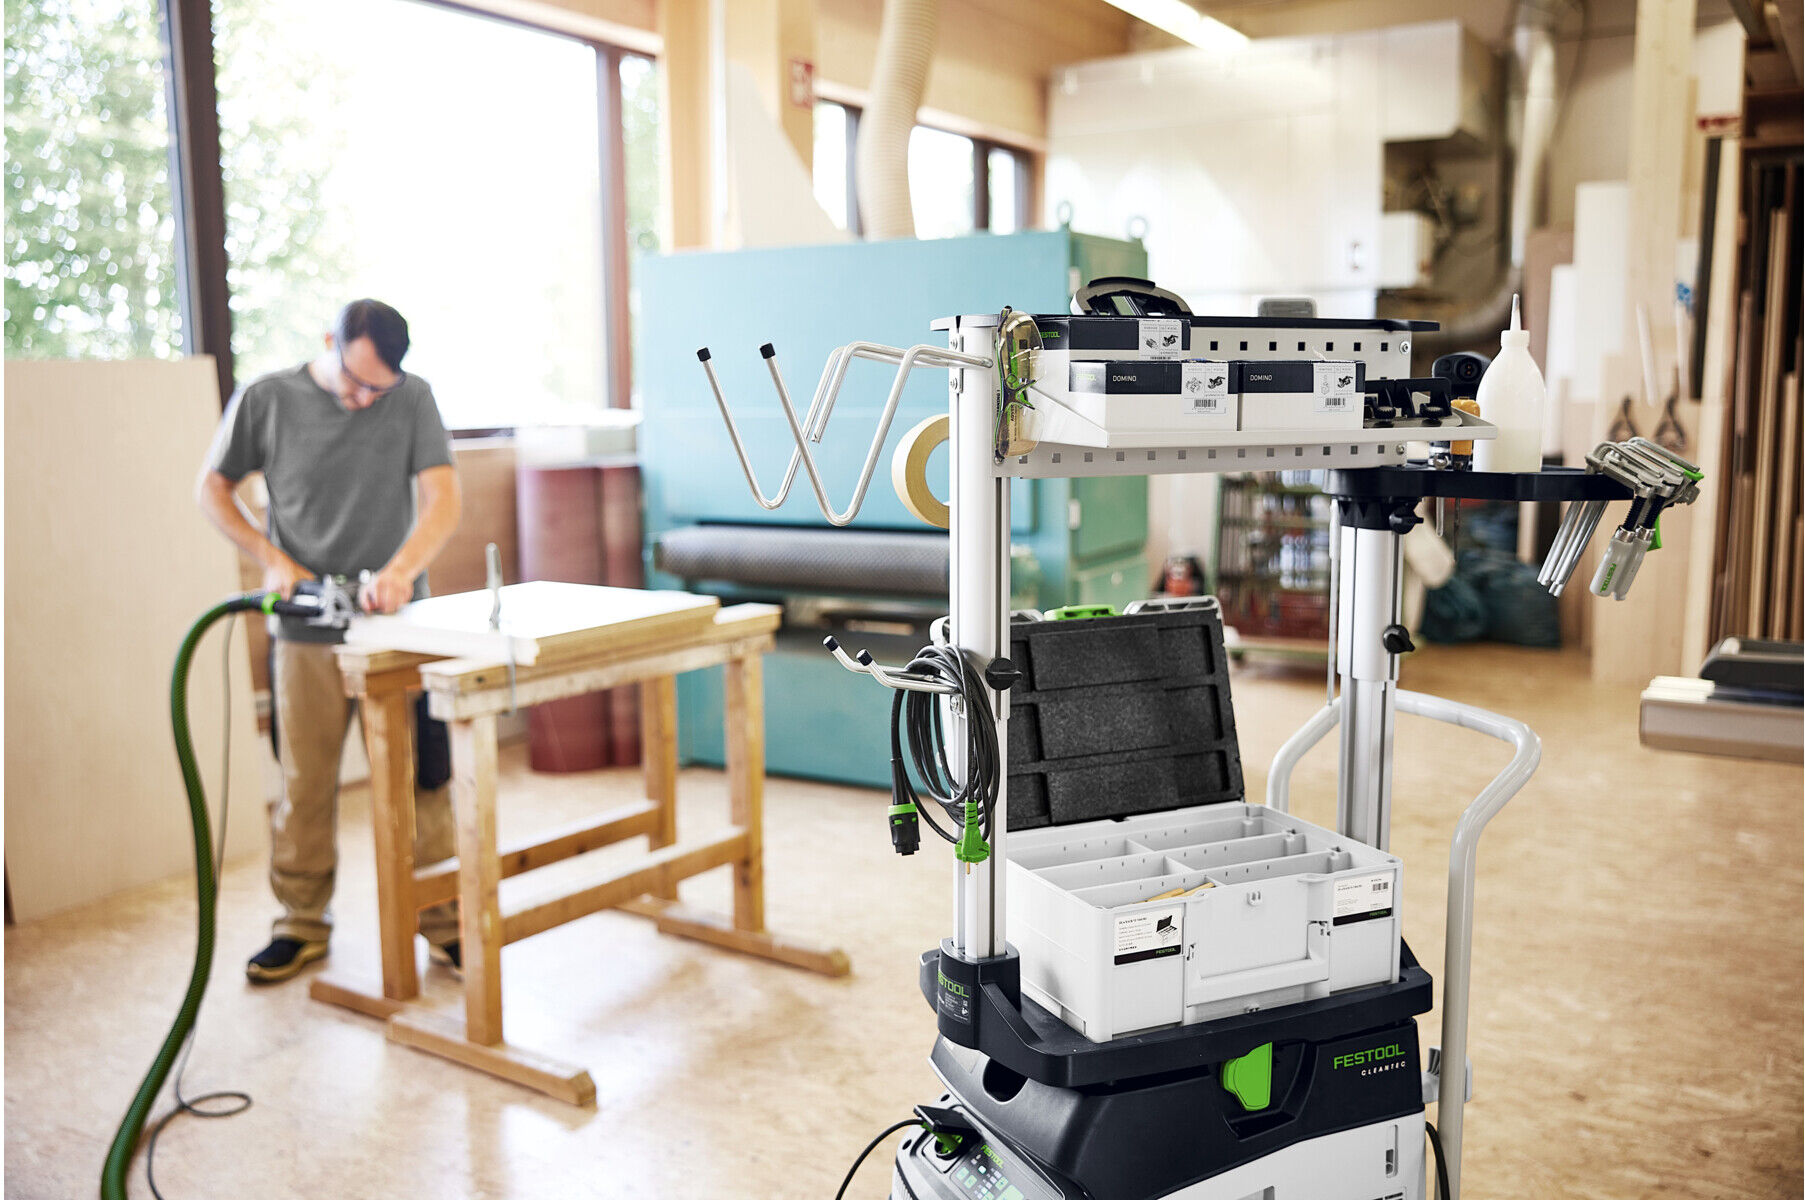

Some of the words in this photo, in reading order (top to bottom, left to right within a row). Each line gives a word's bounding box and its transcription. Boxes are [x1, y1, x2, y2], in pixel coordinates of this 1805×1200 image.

[938, 970, 970, 998] STOOL
[1333, 1043, 1406, 1070] FESTOOL
[1361, 1061, 1406, 1076] CLEANTEC
